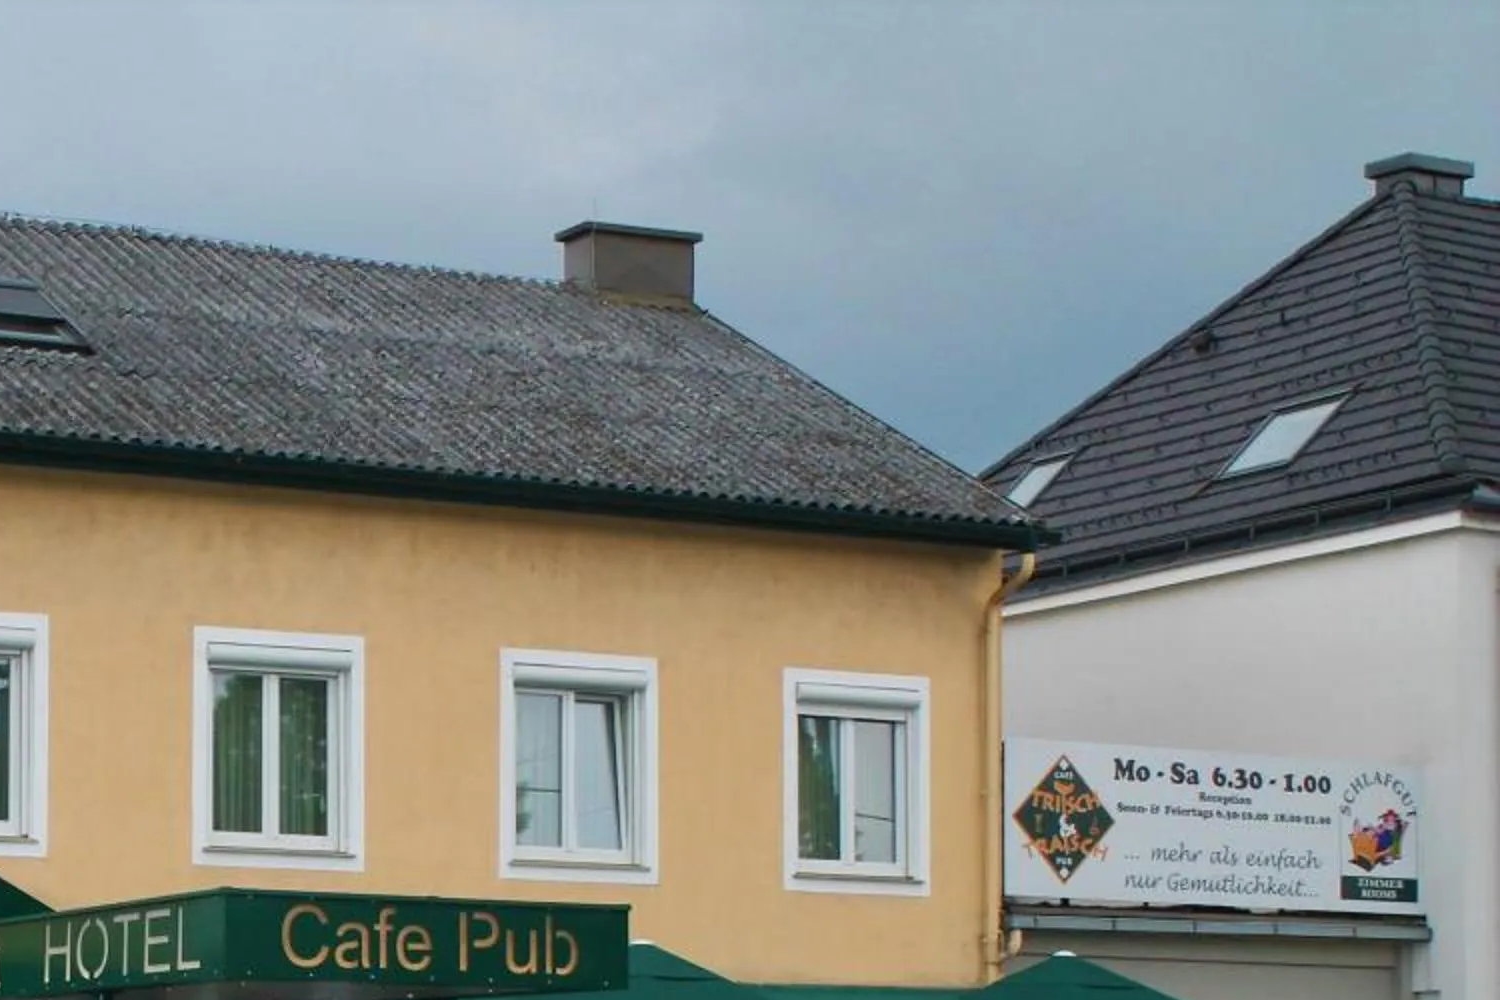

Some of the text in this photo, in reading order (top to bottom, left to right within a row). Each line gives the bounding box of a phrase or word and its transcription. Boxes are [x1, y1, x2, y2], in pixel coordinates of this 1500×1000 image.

[1114, 757, 1151, 782] Mo
[1169, 761, 1200, 786] Sa
[1211, 766, 1263, 790] 6.30
[1282, 773, 1333, 795] 1.00
[1340, 770, 1418, 817] SCHLAFGUT
[1150, 841, 1203, 863] mehr
[1209, 843, 1240, 868] als
[1245, 847, 1324, 872] einfach
[1124, 872, 1162, 889] nur
[43, 906, 202, 984] HOTEL
[281, 903, 579, 976] Cafe Pub
